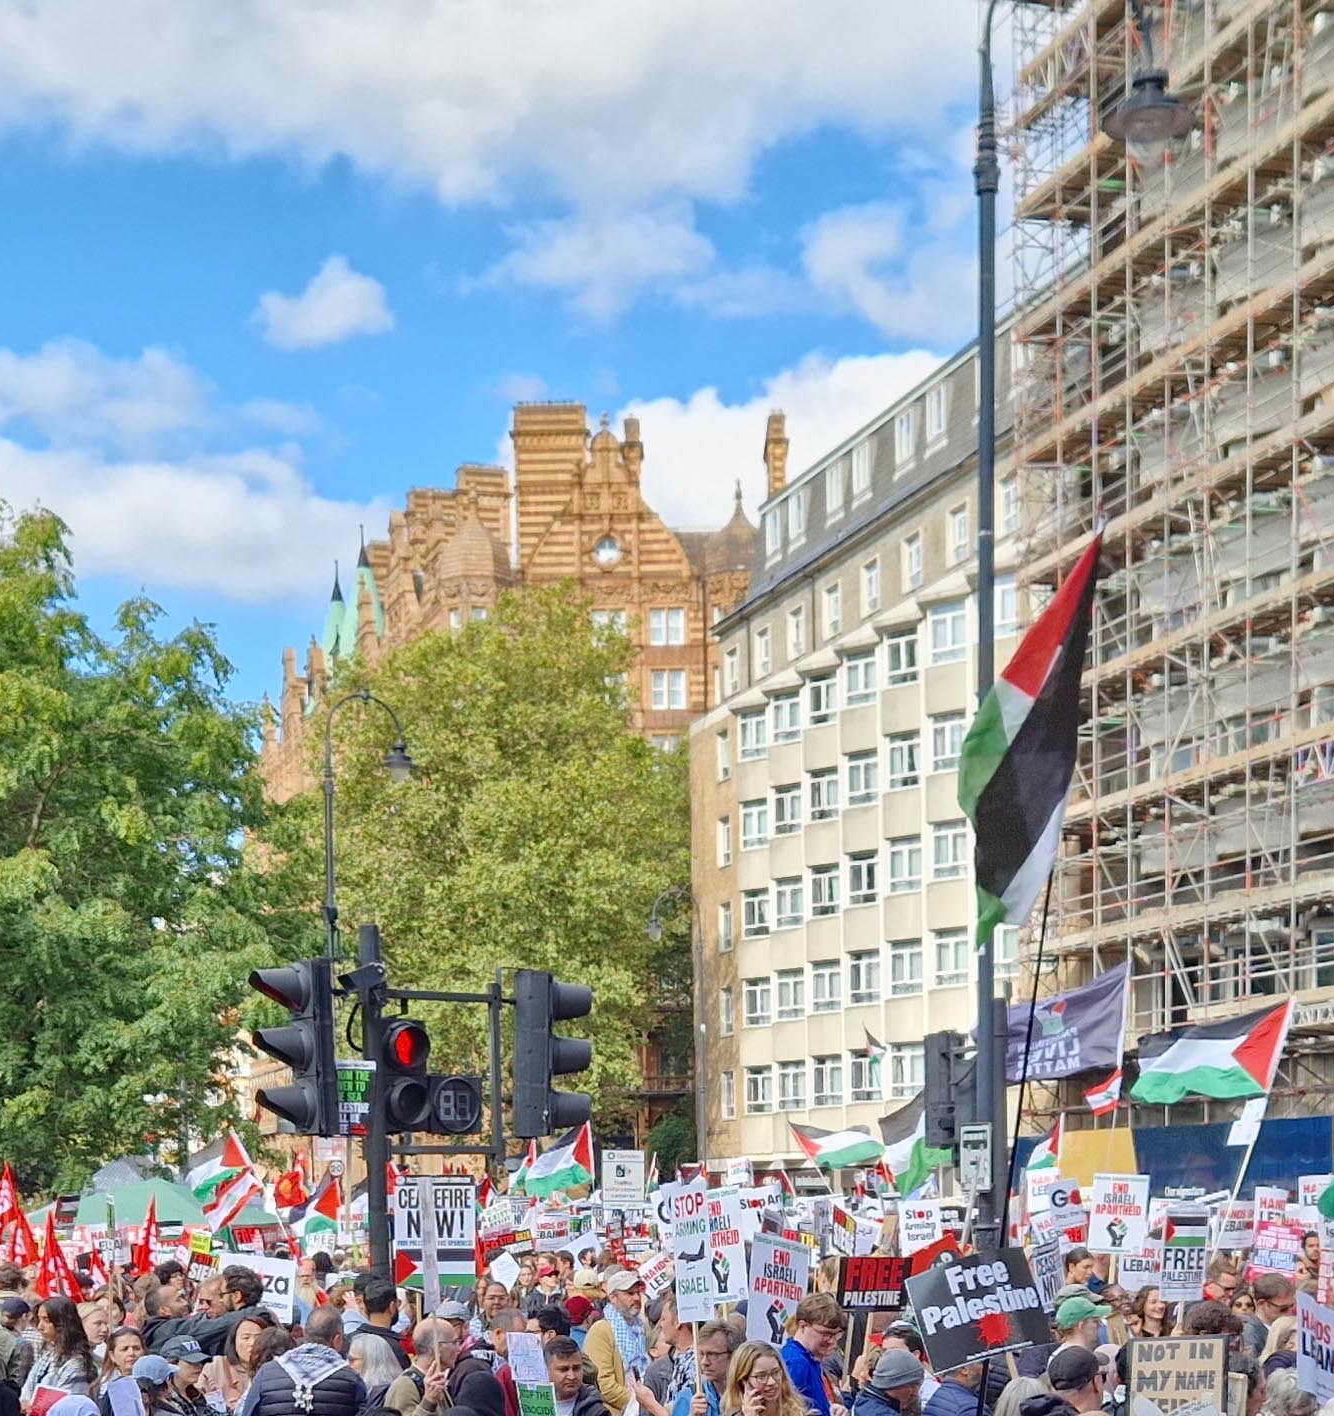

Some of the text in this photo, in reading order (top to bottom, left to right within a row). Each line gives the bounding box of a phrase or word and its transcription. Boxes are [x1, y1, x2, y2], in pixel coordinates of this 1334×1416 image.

[354, 1071, 369, 1081] THE
[355, 1081, 365, 1092] TO
[346, 1092, 363, 1102] SEA
[350, 1113, 361, 1123] BE
[1112, 1183, 1129, 1193] END
[398, 1188, 472, 1209] CEAEFIRE
[674, 1192, 704, 1218] STOP
[1103, 1193, 1136, 1205] ISRAELI
[1094, 1204, 1142, 1217] APARTHEID
[407, 1210, 465, 1238] NW!
[675, 1218, 706, 1238] ARMING
[907, 1231, 936, 1242] Israel
[1256, 1236, 1298, 1251] STOP WAR
[773, 1249, 790, 1266] END
[1163, 1247, 1205, 1270] FREE
[763, 1263, 797, 1284] ISRAELI
[845, 1257, 905, 1291] FREE
[945, 1260, 1010, 1295] Free
[1162, 1271, 1203, 1281] PALESTINE
[677, 1276, 710, 1296] ISRAEL
[753, 1277, 803, 1301] APARTHEID
[843, 1290, 901, 1307] PALESTINE
[921, 1284, 1040, 1336] Palestine
[1137, 1342, 1214, 1363] NOT IN
[1136, 1370, 1216, 1393] MY NAME
[536, 1391, 551, 1401] THE
